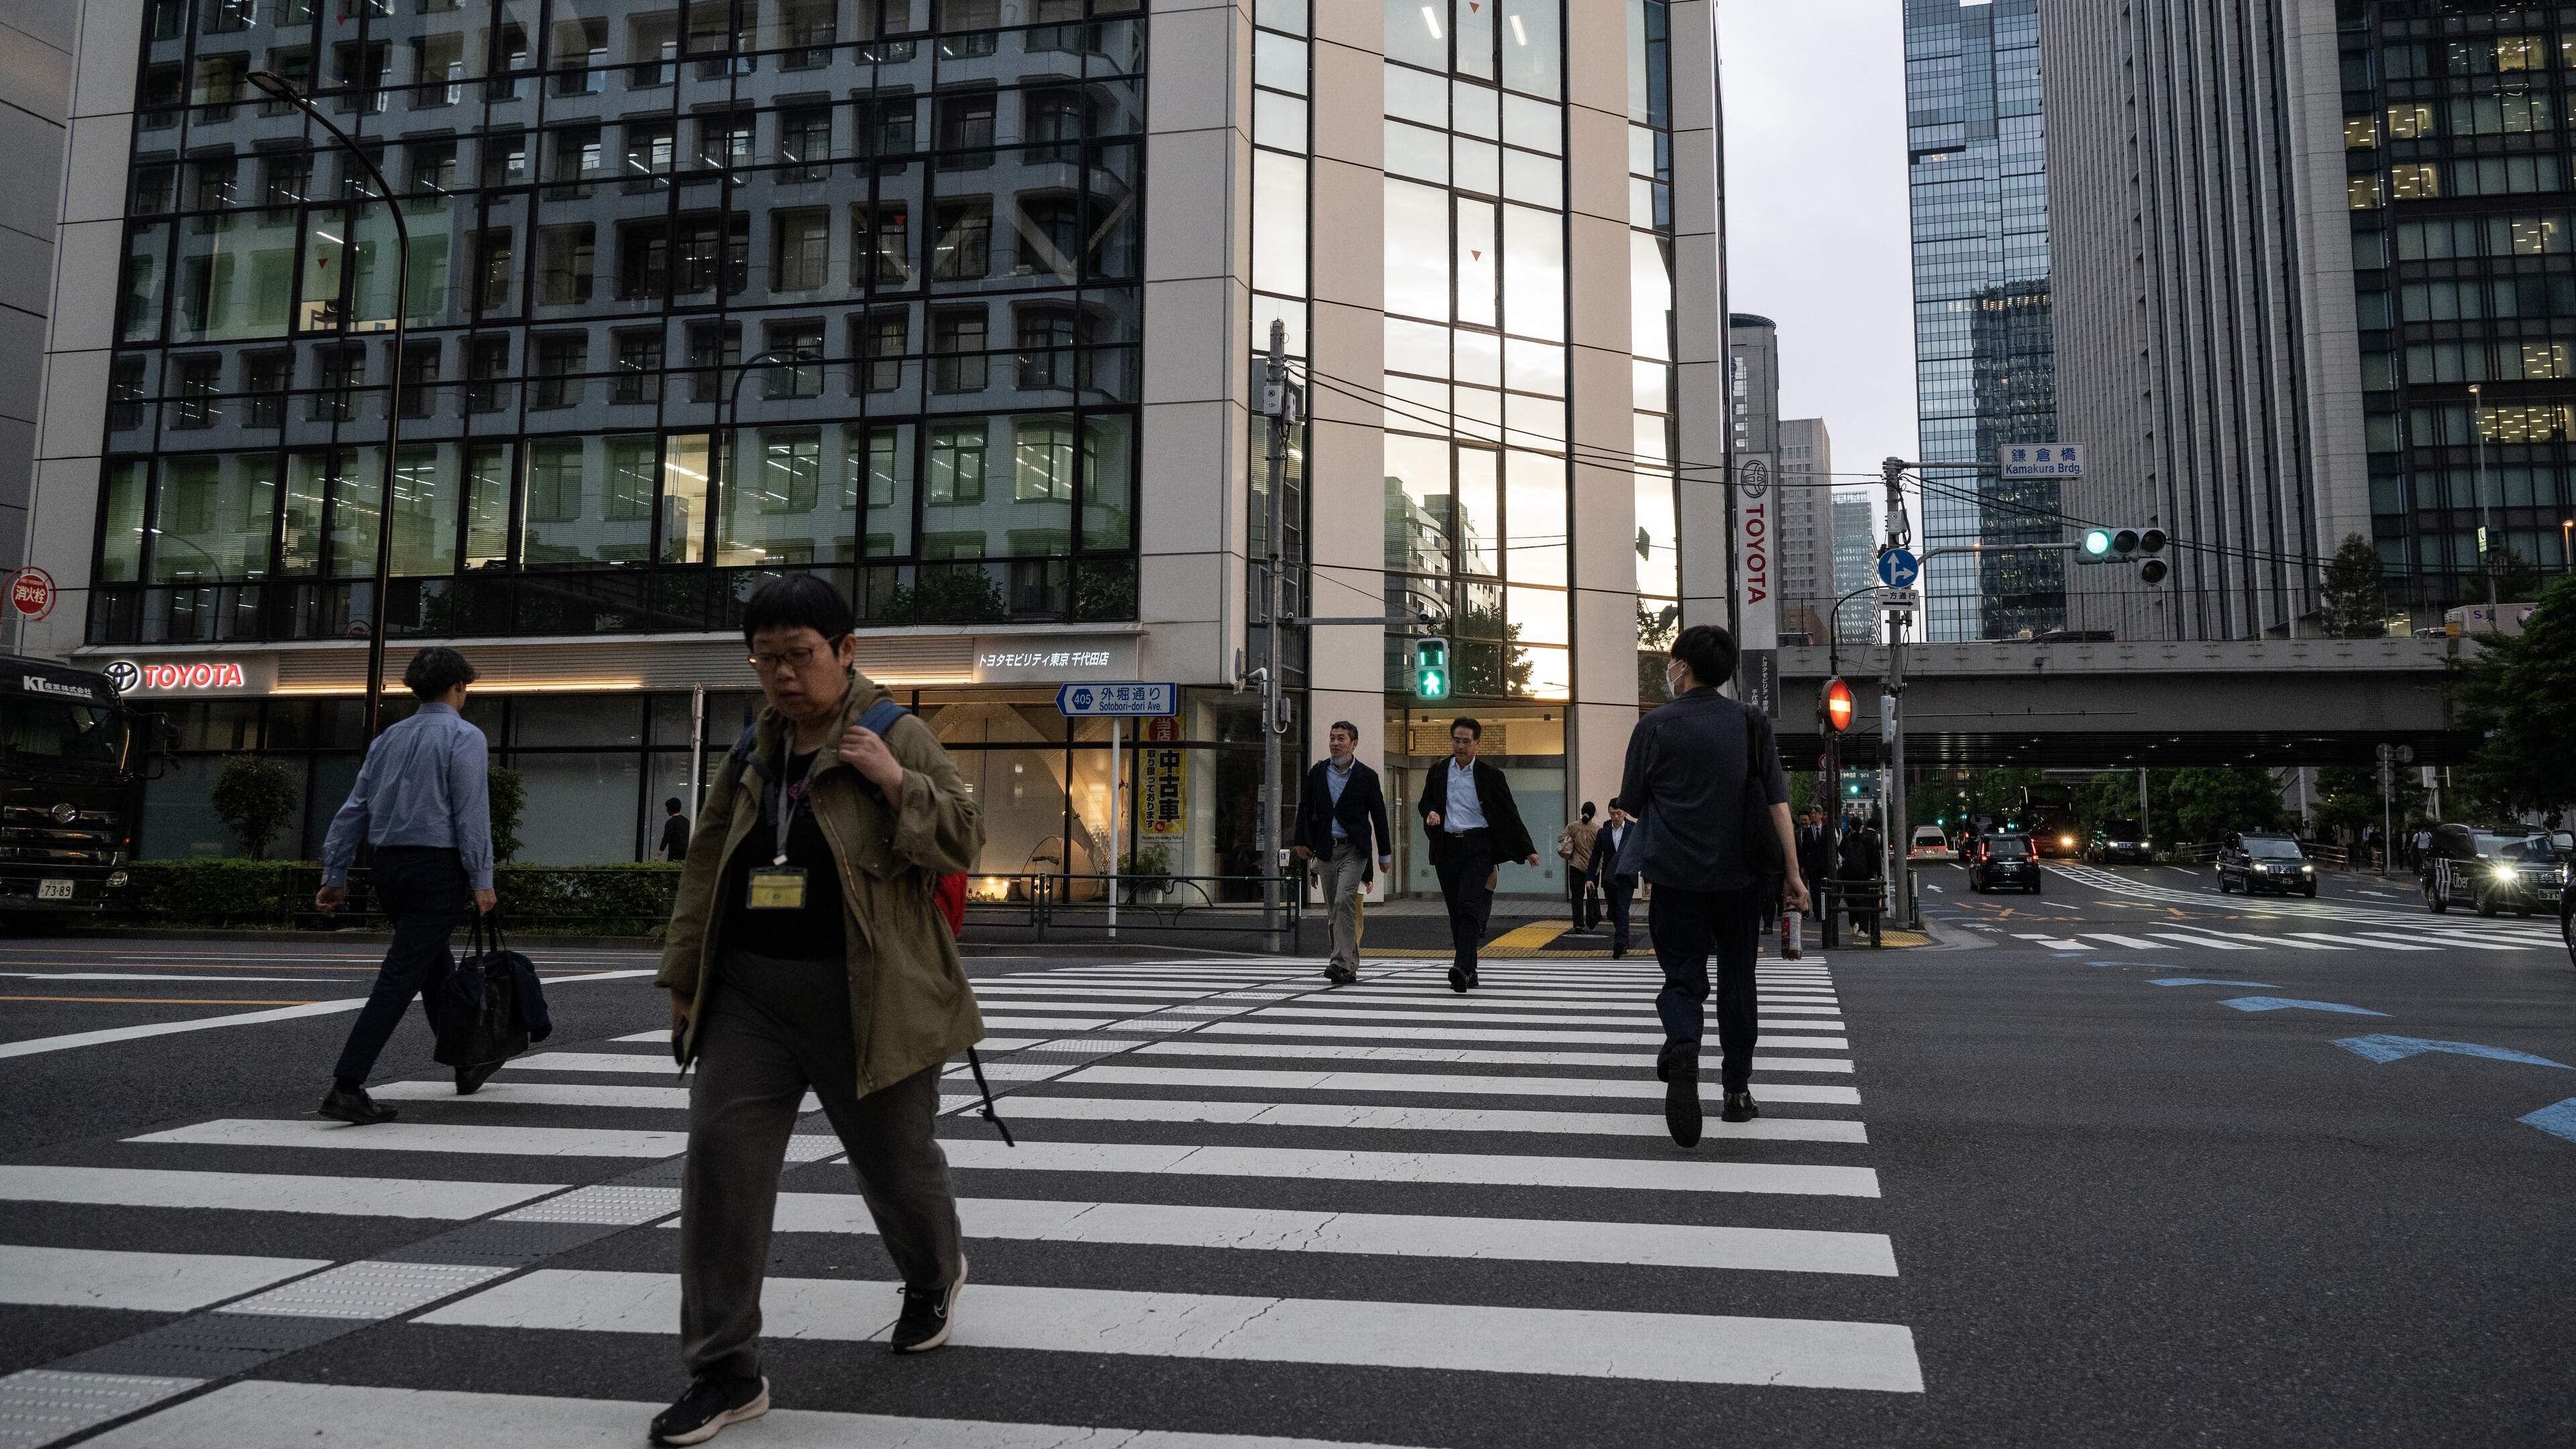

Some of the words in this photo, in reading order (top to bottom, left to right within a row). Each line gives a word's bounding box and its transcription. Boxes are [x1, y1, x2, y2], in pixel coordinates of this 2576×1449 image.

[2011, 447, 2076, 462] 鎌倉橋
[2006, 464, 2054, 474] Kamakura
[2058, 463, 2082, 474] Brdg.
[1746, 503, 1766, 605] TOYOTA
[15, 585, 46, 604] 消火栓
[1880, 592, 1916, 600] 一方通行
[979, 652, 1070, 667] トヨタモビリティ東京
[1071, 651, 1110, 666] 千代田店
[144, 665, 244, 686] TOYOTA
[1074, 694, 1091, 705] 405
[1101, 687, 1161, 701] 外堀通り
[1099, 702, 1145, 711] Sotobori-dori
[1147, 702, 1163, 711] Ave.
[1159, 749, 1180, 822] 中古車
[2452, 872, 2469, 888] Uber
